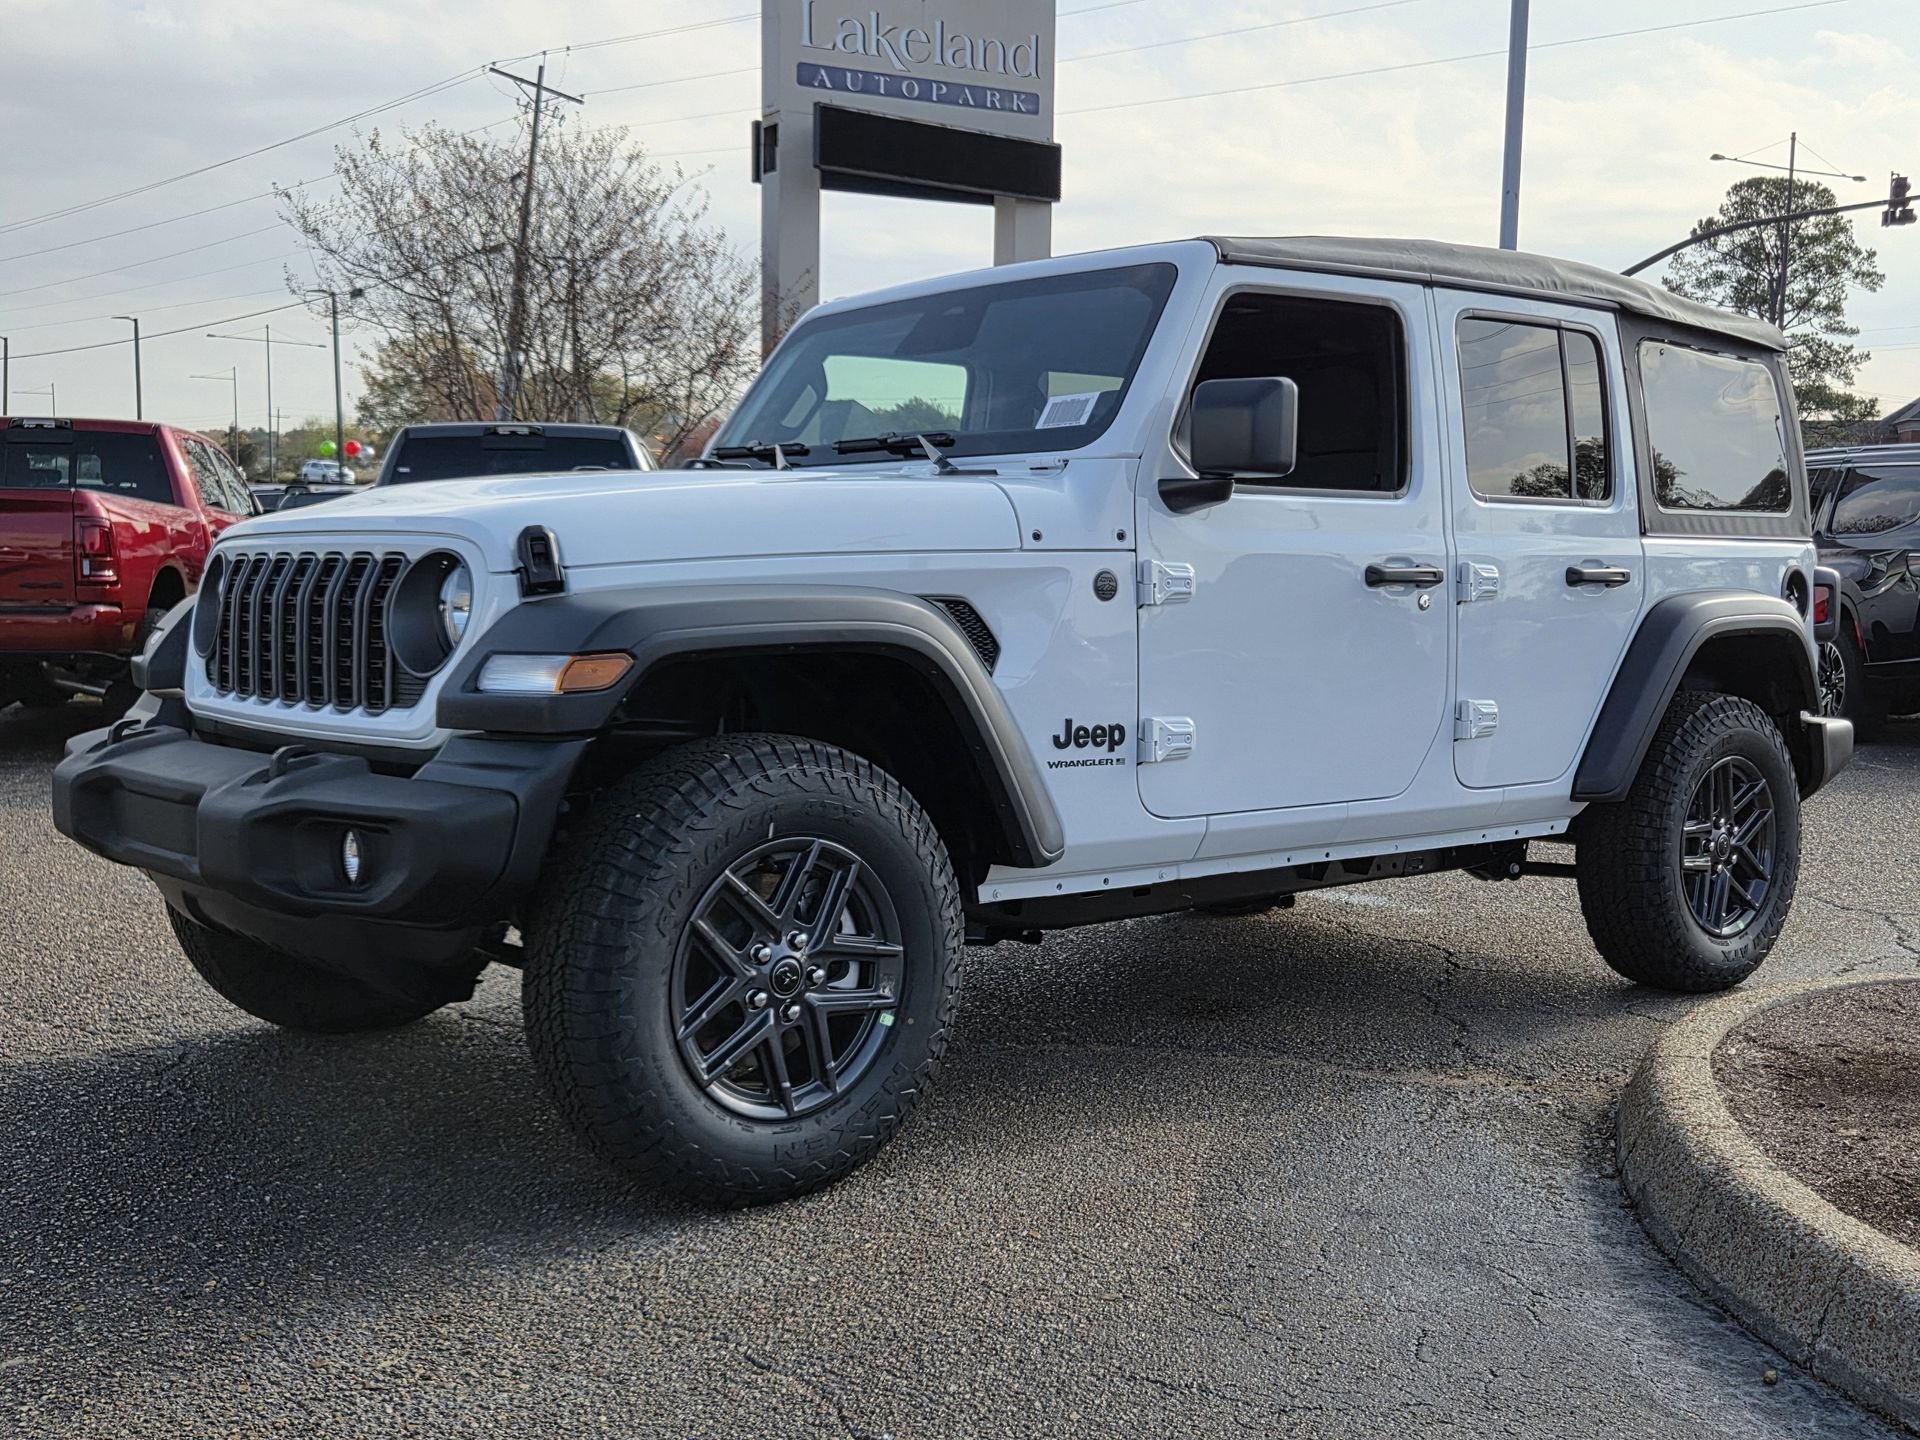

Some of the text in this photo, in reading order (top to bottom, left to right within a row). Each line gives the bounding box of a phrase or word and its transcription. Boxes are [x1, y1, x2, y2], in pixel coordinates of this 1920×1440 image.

[801, 0, 1040, 79] Lakeland
[813, 67, 1027, 113] AUTOPARK
[1052, 717, 1126, 752] Jeep
[1047, 758, 1114, 769] WRANGLER
